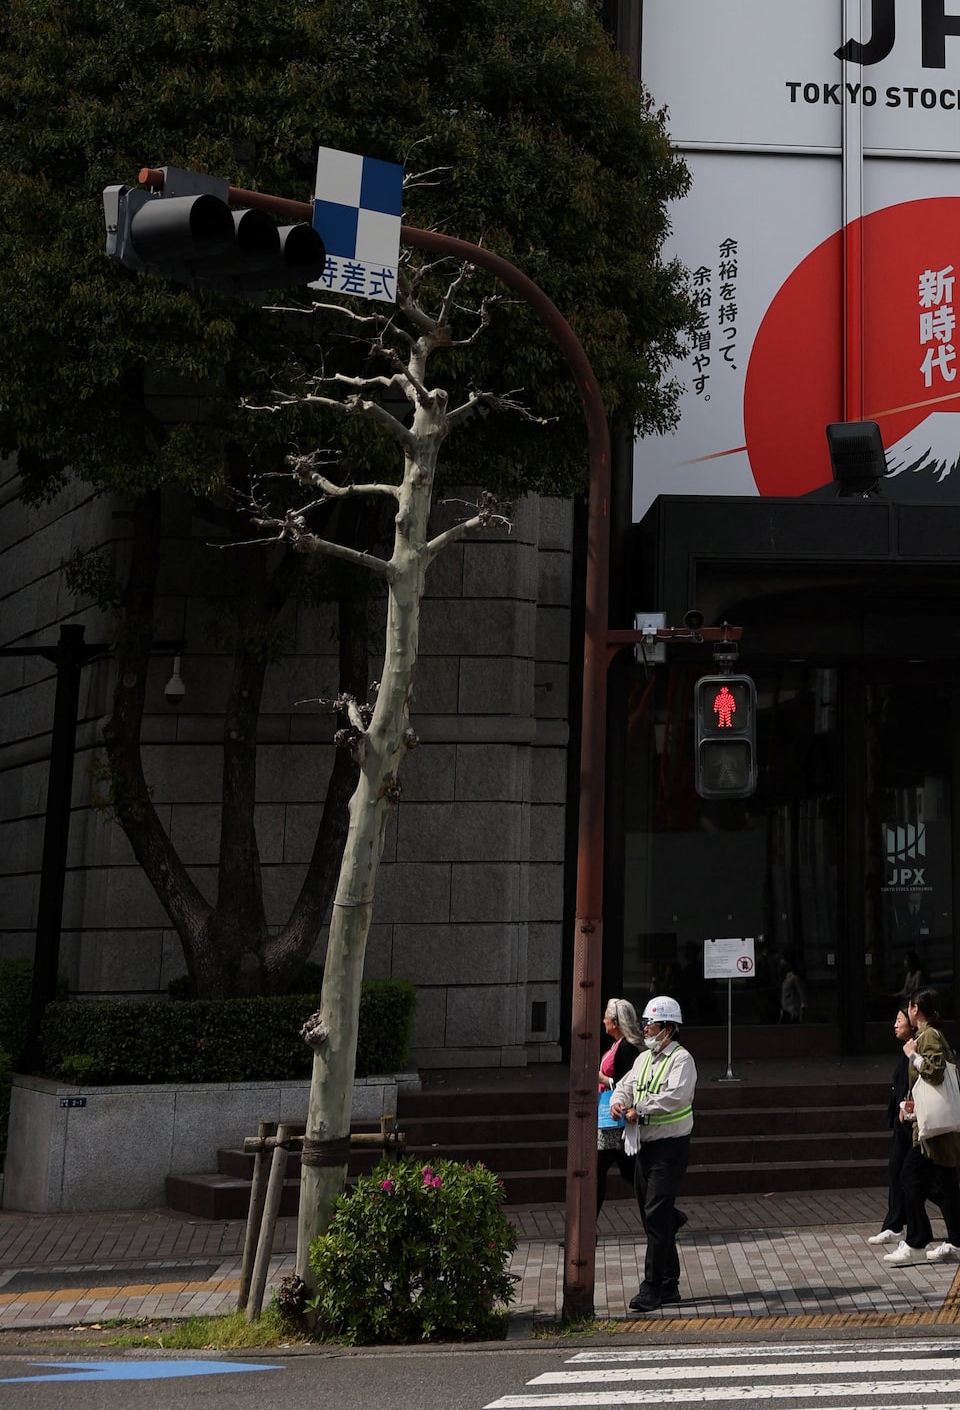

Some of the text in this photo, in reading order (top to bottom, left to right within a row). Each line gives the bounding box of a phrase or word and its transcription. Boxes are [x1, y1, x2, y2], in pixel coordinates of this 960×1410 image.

[785, 81, 877, 108] TOKYO
[691, 265, 712, 402] 余裕を増やす。
[718, 237, 738, 371] 余裕を持って、
[918, 264, 957, 388] 新時代
[888, 868, 926, 885] JPX
